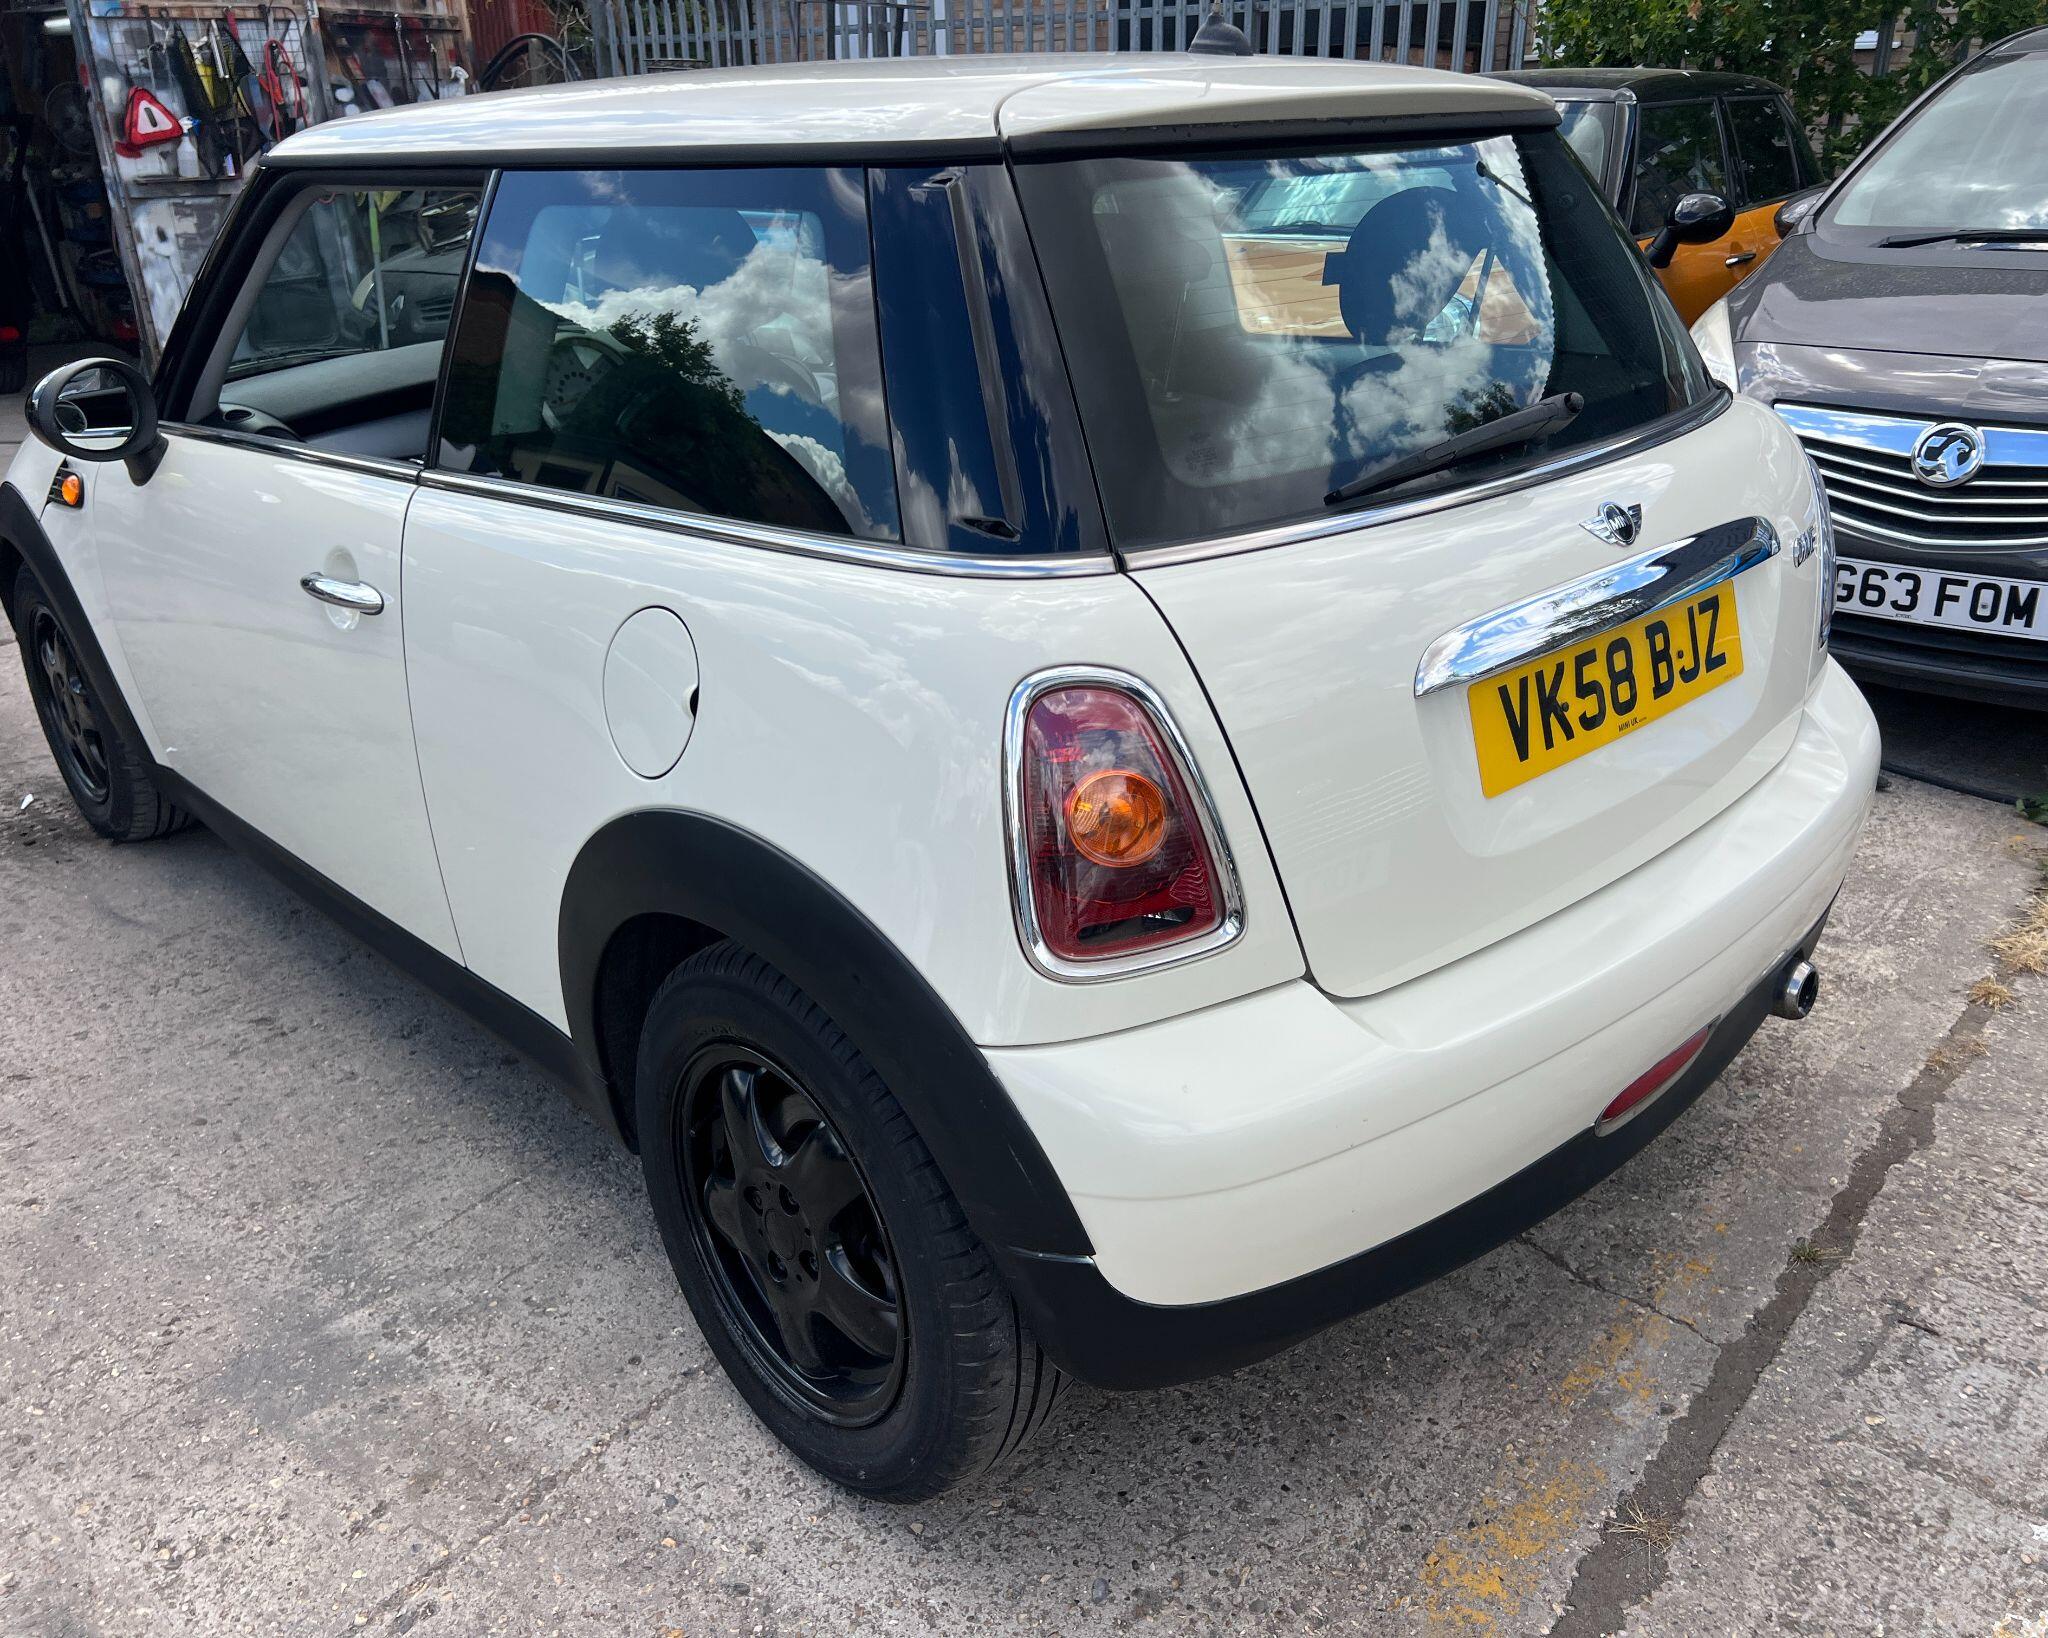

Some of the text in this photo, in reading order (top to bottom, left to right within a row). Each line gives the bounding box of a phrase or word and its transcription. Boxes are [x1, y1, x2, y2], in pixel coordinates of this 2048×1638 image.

[1933, 577, 2040, 628] FOM
[1498, 594, 1726, 762] VK58 BJZ
